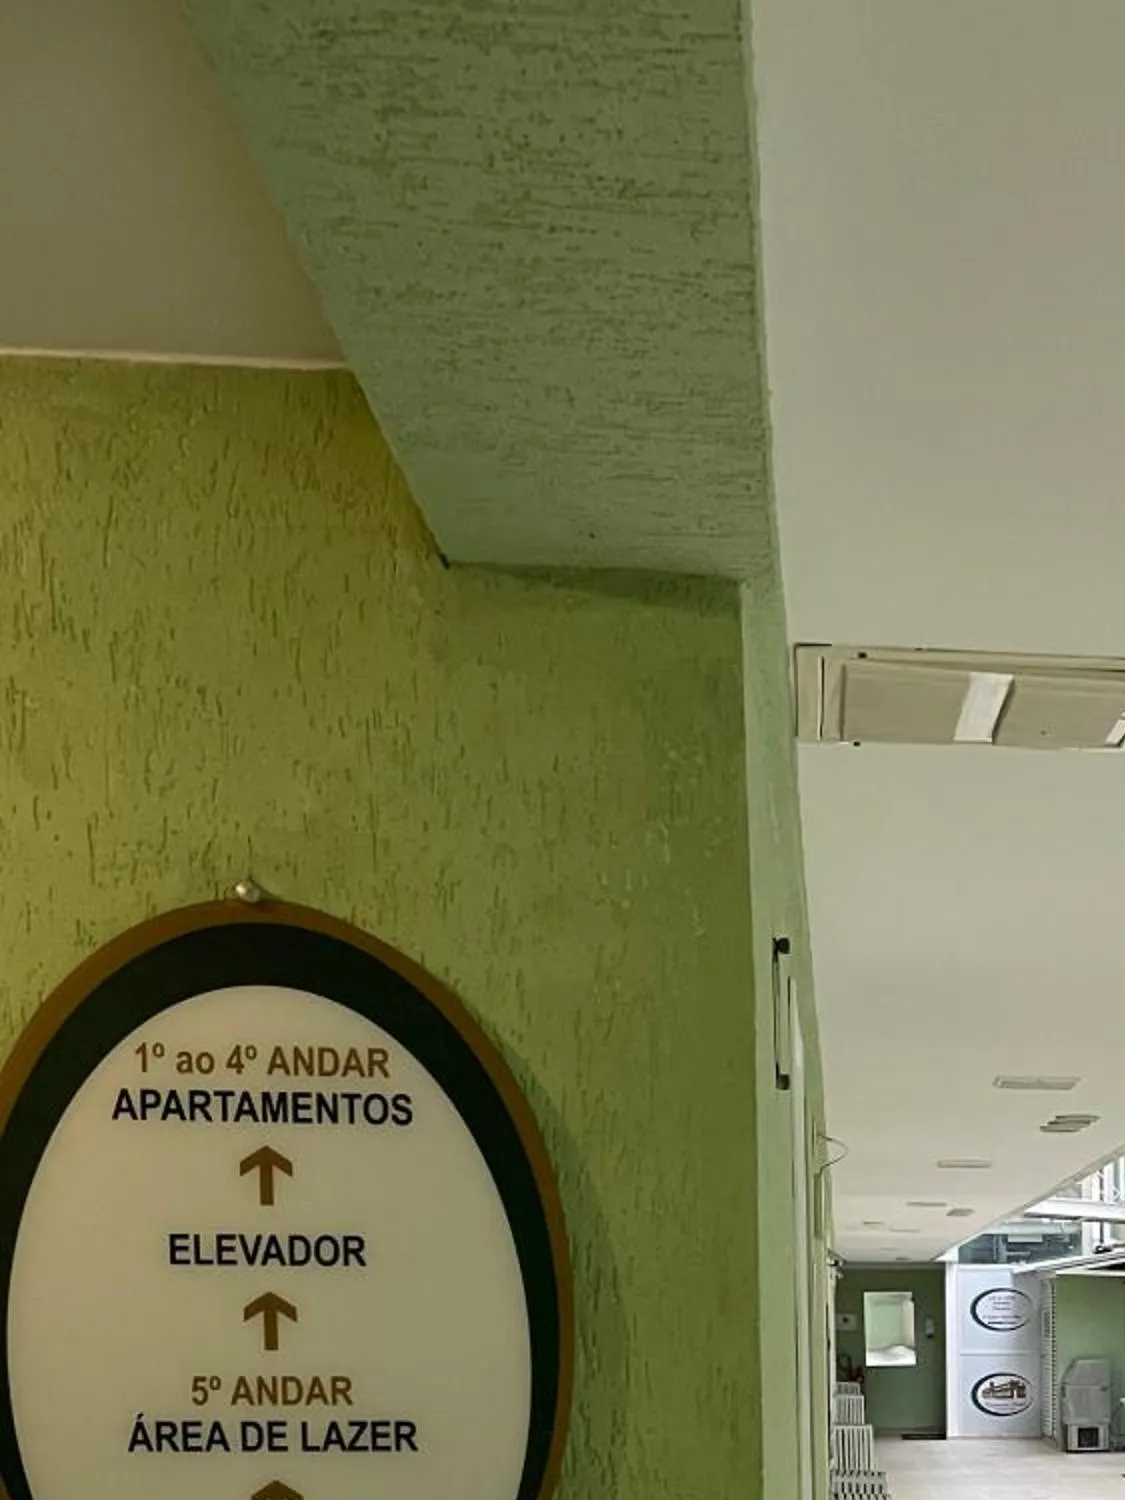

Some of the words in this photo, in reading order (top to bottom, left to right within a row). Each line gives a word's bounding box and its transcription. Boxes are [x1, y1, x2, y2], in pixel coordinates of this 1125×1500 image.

[176, 1050, 215, 1076] ao
[267, 1045, 391, 1079] ANDAR
[112, 1087, 413, 1127] APARTAMENTOS
[168, 1233, 368, 1268] ELEVADOR
[231, 1375, 354, 1407] ANDAR
[128, 1412, 231, 1453] ÁREA
[239, 1420, 289, 1453] DE
[300, 1420, 420, 1453] LAZER
